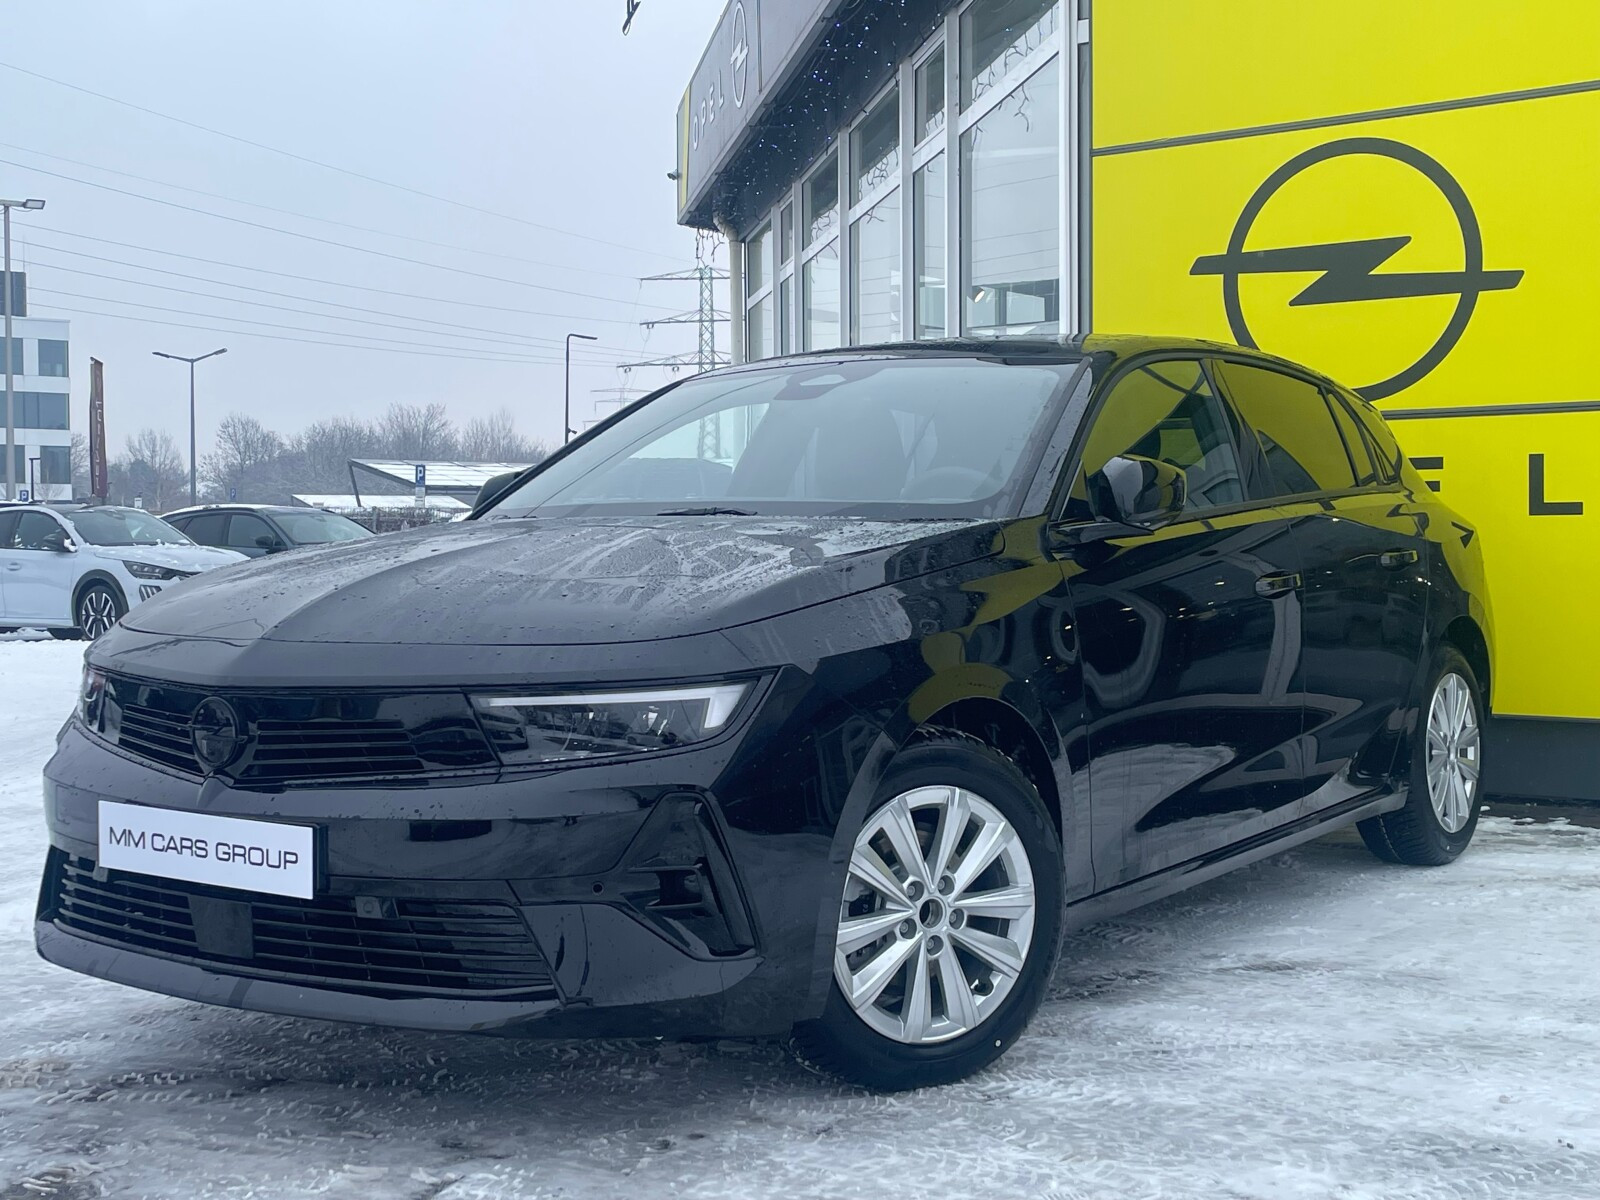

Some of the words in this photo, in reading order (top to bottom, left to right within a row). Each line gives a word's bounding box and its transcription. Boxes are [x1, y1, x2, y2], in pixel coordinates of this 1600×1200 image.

[693, 69, 725, 151] OPEL
[417, 466, 424, 480] P
[1408, 453, 1584, 515] L
[109, 826, 146, 849] MM
[151, 832, 208, 858] CARS
[215, 841, 299, 870] GROUP
